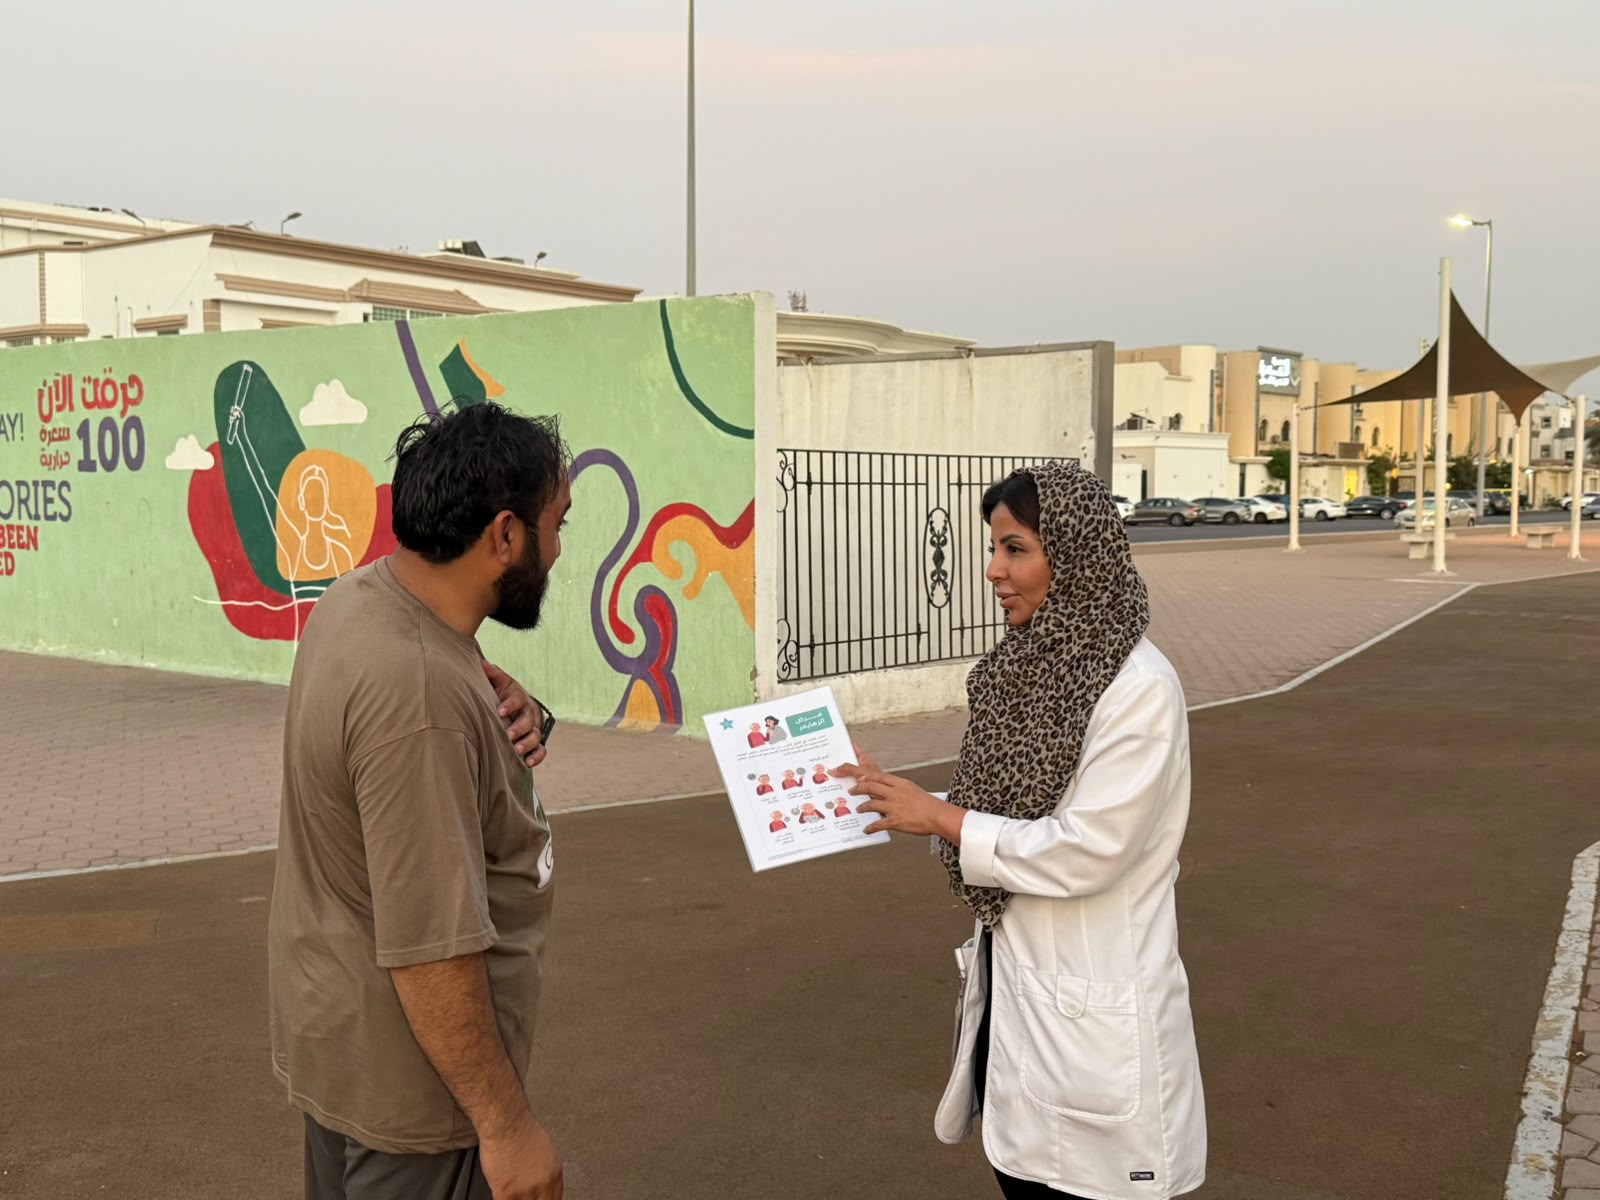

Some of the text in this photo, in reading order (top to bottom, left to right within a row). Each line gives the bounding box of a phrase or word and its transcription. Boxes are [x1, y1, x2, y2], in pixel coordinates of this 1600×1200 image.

[37, 366, 144, 424] حرقت الآن
[39, 424, 71, 448] سعرة
[76, 415, 145, 473] 100
[39, 447, 71, 472] حرارية
[0, 479, 72, 522] ORIES
